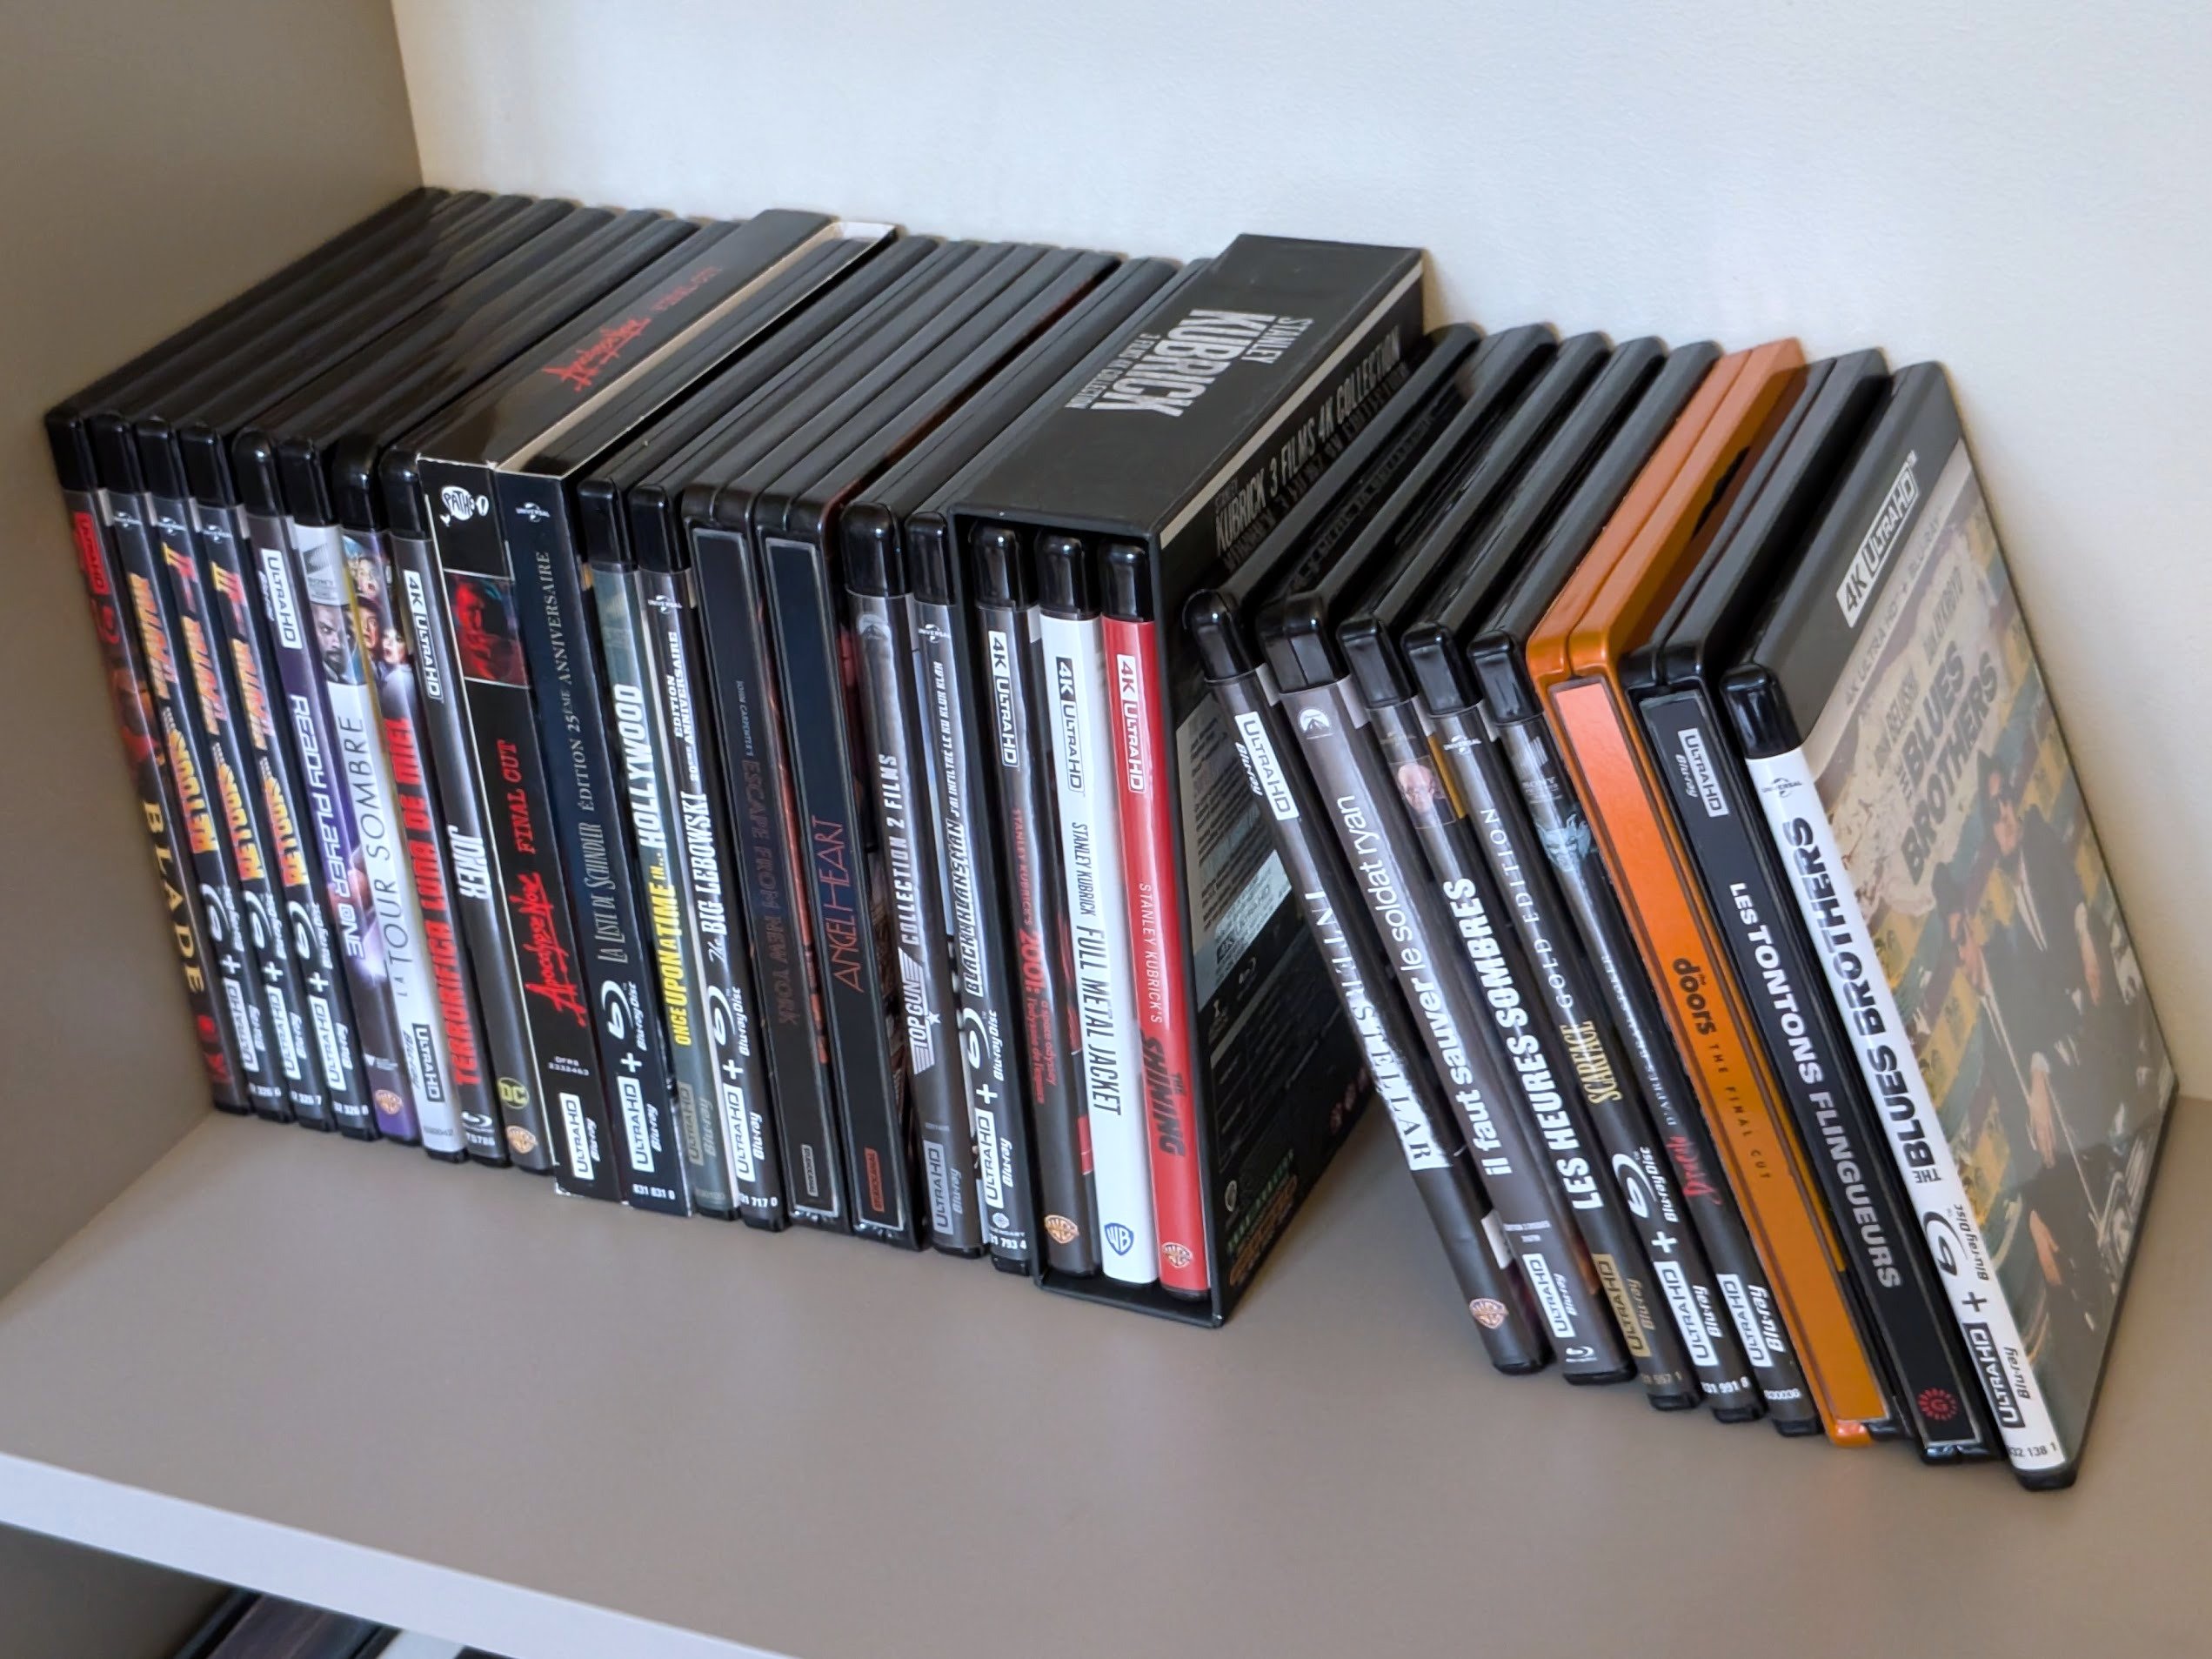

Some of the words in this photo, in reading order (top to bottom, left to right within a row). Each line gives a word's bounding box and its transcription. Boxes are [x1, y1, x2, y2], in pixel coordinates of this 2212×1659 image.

[1091, 309, 1275, 417] KUBRICK
[1243, 316, 1314, 364] STANLEY
[1215, 470, 1266, 555] KUBRICK
[1269, 458, 1279, 495] 3
[1281, 418, 1317, 486] FILMS
[1318, 395, 1337, 445] 4K
[1337, 326, 1400, 425] COLLECTION
[163, 543, 197, 582] II
[208, 560, 247, 605] III
[406, 573, 424, 610] 4K
[1846, 565, 1868, 611] 4K
[536, 552, 571, 684] ANNIVERSAIRE
[933, 661, 946, 689] KLAN
[992, 637, 1006, 668] 4K
[1059, 661, 1074, 694] 4K
[1120, 660, 1135, 692] 4K
[665, 629, 696, 745] ANNIVERSAIRE
[937, 690, 948, 718] KLUX
[1900, 641, 1965, 777] BLUES
[384, 713, 424, 786] MIEL
[939, 719, 950, 733] KU
[941, 734, 952, 747] LE
[159, 728, 221, 857] RETOUR
[338, 718, 384, 857] SOMBRE
[498, 739, 521, 782] CUT
[570, 739, 594, 811] ÉDITION
[614, 685, 665, 848] HOLLYWOOD
[879, 753, 902, 809] FILMS
[1900, 644, 1999, 886] BROTHERS
[217, 763, 265, 879] RETOUR
[291, 695, 327, 788] READY
[310, 793, 351, 898] PLAYER
[337, 903, 366, 959] ONE
[398, 792, 432, 833] DE
[507, 789, 535, 853] FINAL
[742, 759, 769, 839] ESCAPE
[885, 816, 905, 828] 2
[1333, 792, 1380, 855] ryan
[256, 774, 311, 890] RETOUR
[448, 826, 492, 900] JOKER
[578, 822, 615, 889] SCHINDLER
[681, 793, 720, 894] LEBOWSKI
[812, 816, 852, 912] HEART
[1072, 822, 1091, 868] STANLEY
[144, 804, 204, 989] BLADE
[411, 842, 450, 912] LUNA
[890, 835, 918, 945] COLLECTION
[1077, 870, 1094, 914] KUBRICK
[1481, 806, 1538, 923] EDITION
[373, 879, 411, 963] TOUR
[591, 894, 615, 909] DE
[594, 913, 625, 943] LISTE
[650, 883, 681, 939] TIME
[698, 900, 726, 935] BIG
[1138, 881, 1156, 947] STANLEY
[1356, 857, 1413, 942] soldat
[1794, 819, 1884, 1034] BROTHERS
[598, 948, 627, 963] LA
[659, 936, 674, 948] A
[825, 915, 862, 992] ANGEL
[1076, 926, 1104, 969] FULL
[1392, 945, 1429, 974] le
[1445, 877, 1527, 1027] SOMBRES
[1534, 937, 1573, 1009] GOLD
[393, 976, 408, 997] LA
[425, 920, 489, 1087] TERRORIFICA
[658, 950, 687, 1006] UPON
[902, 981, 926, 1017] GUN
[1082, 977, 1113, 1037] METAL
[1144, 950, 1161, 1020] KUBRICK'S
[670, 1007, 692, 1045] ONCE
[906, 1017, 928, 1047] TOP
[1413, 979, 1472, 1083] sauver
[1088, 1045, 1121, 1114] JACKET
[1561, 1017, 1621, 1102] SCARFACE
[1674, 959, 1716, 1034] doors
[1709, 1044, 1728, 1073] THE
[1725, 1086, 1751, 1136] FINAL
[1750, 1149, 1771, 1178] CUT
[1729, 883, 1758, 923] LES
[1748, 924, 1821, 1082] TONTONS
[1811, 1092, 1900, 1286] FLINGUEURS
[1140, 1032, 1180, 1152] SHINING
[1456, 1090, 1500, 1151] faut
[1507, 1035, 1577, 1149] HEURES
[1869, 1046, 1934, 1167] BLUES
[1481, 1157, 1512, 1175] il
[1557, 1157, 1601, 1209] LES
[1910, 1165, 1941, 1184] THE
[1954, 1205, 1971, 1231] Disc
[1966, 1234, 1989, 1281] Blu-ray
[1748, 1285, 1784, 1352] Blu-ray
[2004, 1347, 2031, 1399] Blu-ray
[2027, 1443, 2048, 1458] 138
